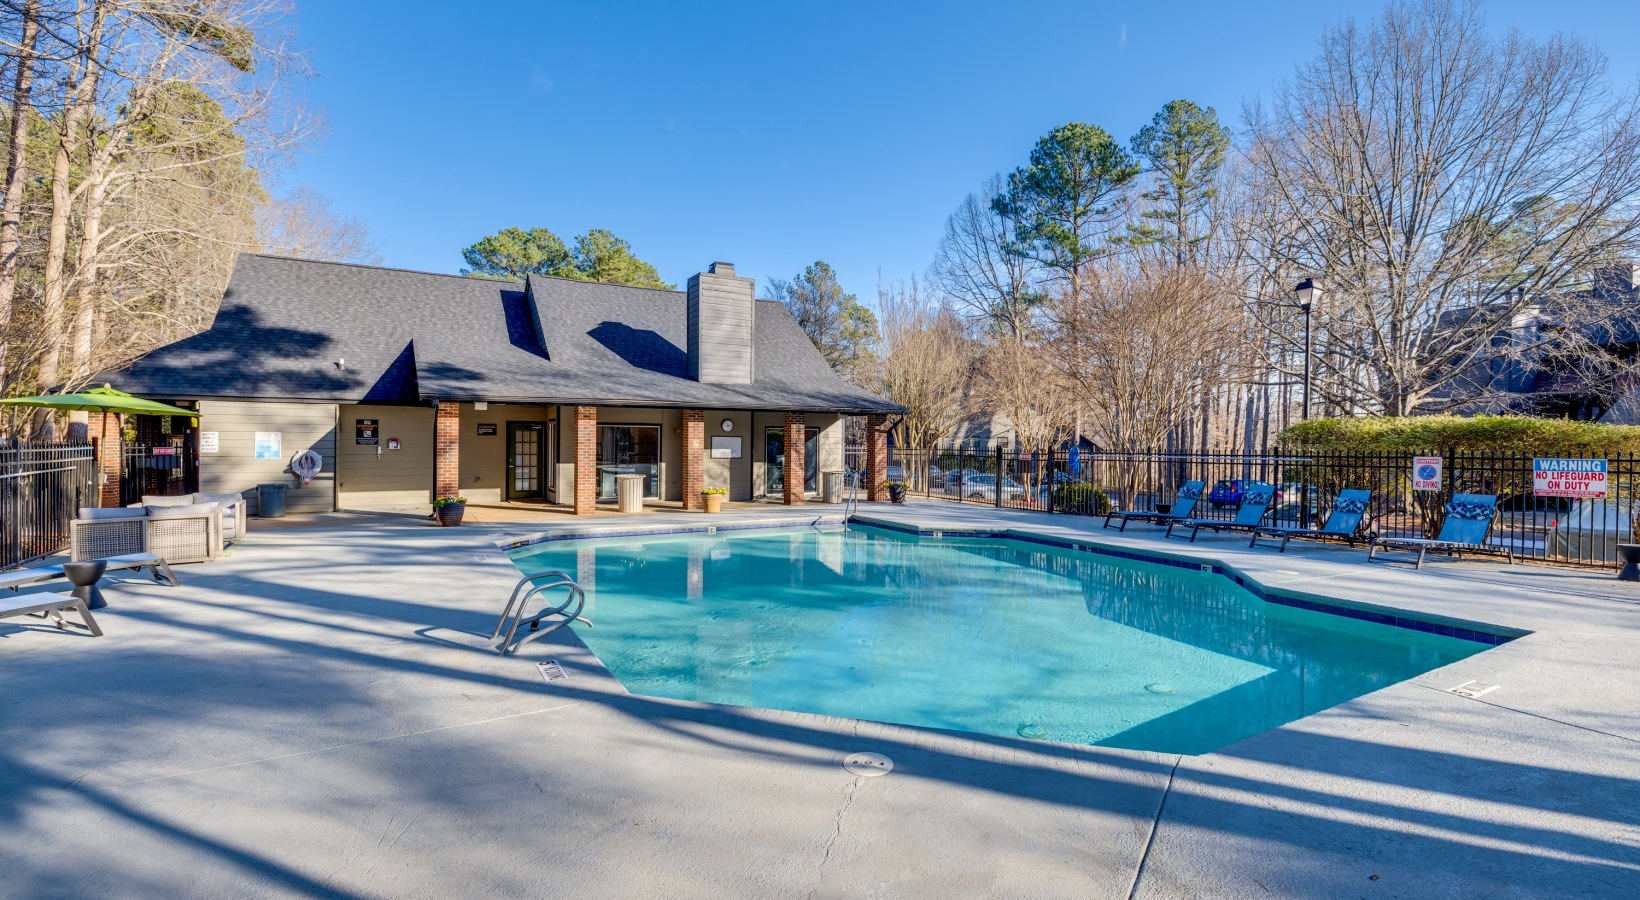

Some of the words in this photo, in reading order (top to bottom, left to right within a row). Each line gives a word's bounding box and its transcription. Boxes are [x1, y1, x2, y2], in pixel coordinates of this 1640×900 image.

[1540, 460, 1602, 472] WARNING
[1535, 471, 1548, 480] NO
[1552, 472, 1605, 481] LIFEGUARD
[1547, 481, 1561, 489] ON
[1564, 481, 1590, 490] DUTY
